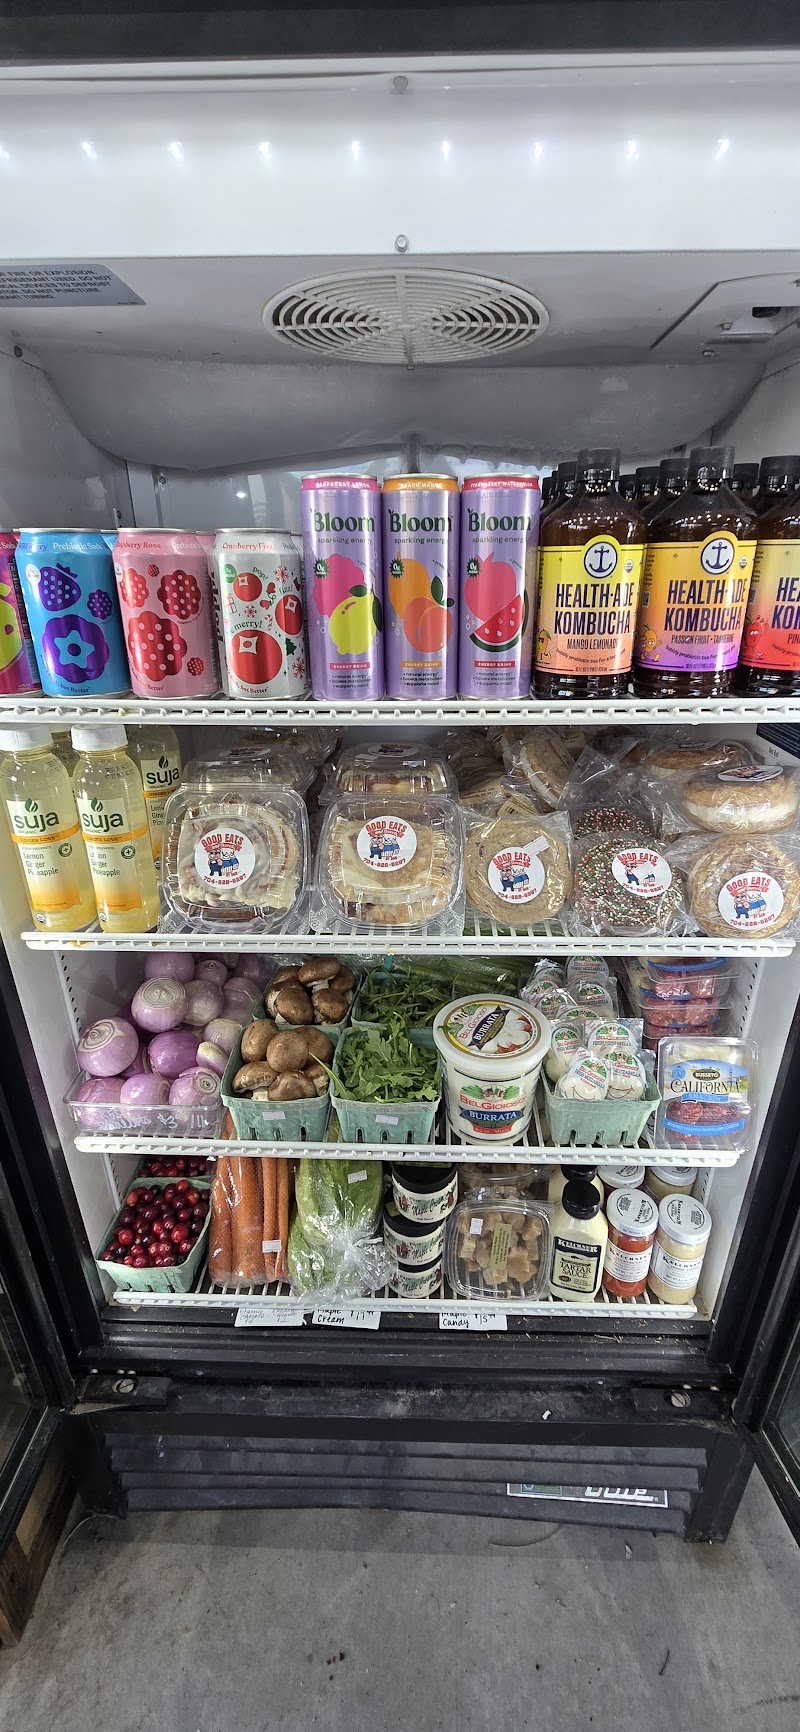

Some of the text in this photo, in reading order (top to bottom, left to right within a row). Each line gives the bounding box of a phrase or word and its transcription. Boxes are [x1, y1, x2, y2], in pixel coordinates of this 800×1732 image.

[313, 509, 375, 532] Bloom
[389, 509, 452, 532] Bloom
[468, 509, 532, 532] Bloom
[53, 542, 87, 550] Prebiotic
[222, 542, 258, 551] Cranberry
[394, 537, 448, 545] sparkling energ
[472, 536, 502, 544] sparkling
[252, 566, 268, 581] pop!
[278, 584, 293, 595] fizz!
[554, 609, 631, 635] KOMBUCHA
[664, 606, 743, 632] KOMBUCHA
[233, 620, 263, 632] merry!
[567, 639, 589, 649] MANGO
[694, 635, 710, 645] FRUIT
[250, 686, 269, 694] Better
[146, 767, 179, 786] suja
[14, 812, 59, 832] suja
[82, 813, 124, 833] suja
[366, 821, 408, 833] GOOD EATS
[201, 834, 244, 847] GOOD EATS
[23, 852, 45, 860] Lemon
[492, 852, 512, 866] GOOD
[617, 852, 658, 863] GOOD EATS
[726, 876, 771, 892] GOOD EATS
[458, 1007, 488, 1039] BELGIOIOSO
[473, 1013, 500, 1041] BURRATA
[670, 1080, 741, 1094] CALIFORNIA
[459, 1094, 525, 1110] BELGIOIOSO
[469, 1110, 517, 1121] BURRATA
[559, 1261, 592, 1274] TARTAR
[562, 1268, 589, 1279] SAUCE
[317, 1315, 345, 1325] Cream
[442, 1318, 470, 1328] Candy
